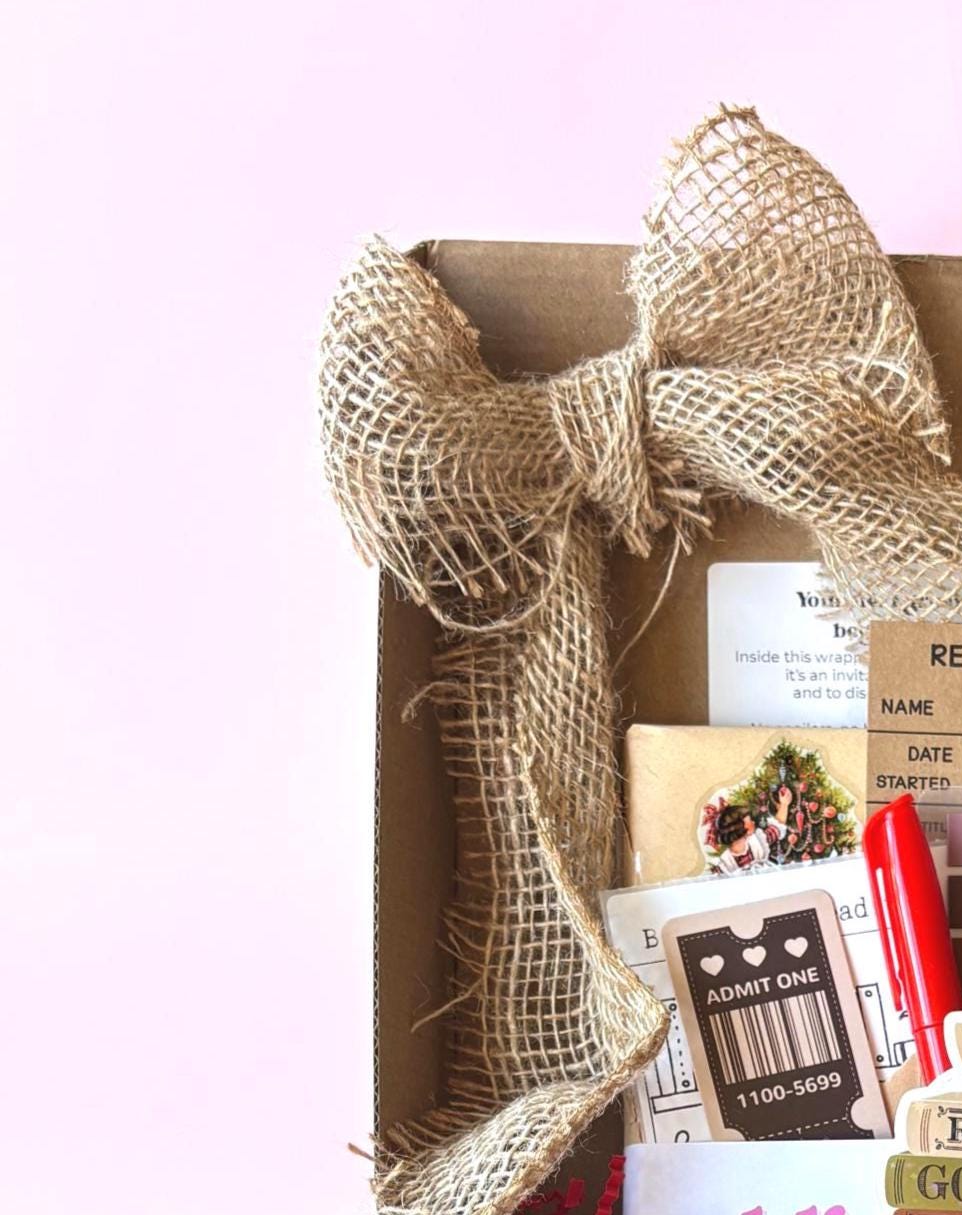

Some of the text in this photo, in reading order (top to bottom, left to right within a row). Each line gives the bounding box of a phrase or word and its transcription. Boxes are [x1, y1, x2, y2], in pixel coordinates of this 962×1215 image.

[735, 651, 780, 664] Inside
[784, 650, 812, 664] this
[785, 668, 806, 682] it's
[809, 670, 828, 682] an
[793, 686, 822, 700] and
[826, 688, 842, 700] to
[881, 698, 934, 716] NAME
[908, 746, 953, 763] DATE
[876, 774, 951, 791] STARTED
[706, 966, 821, 1006] ADMIT ONE
[736, 1072, 842, 1109] 1100-5699
